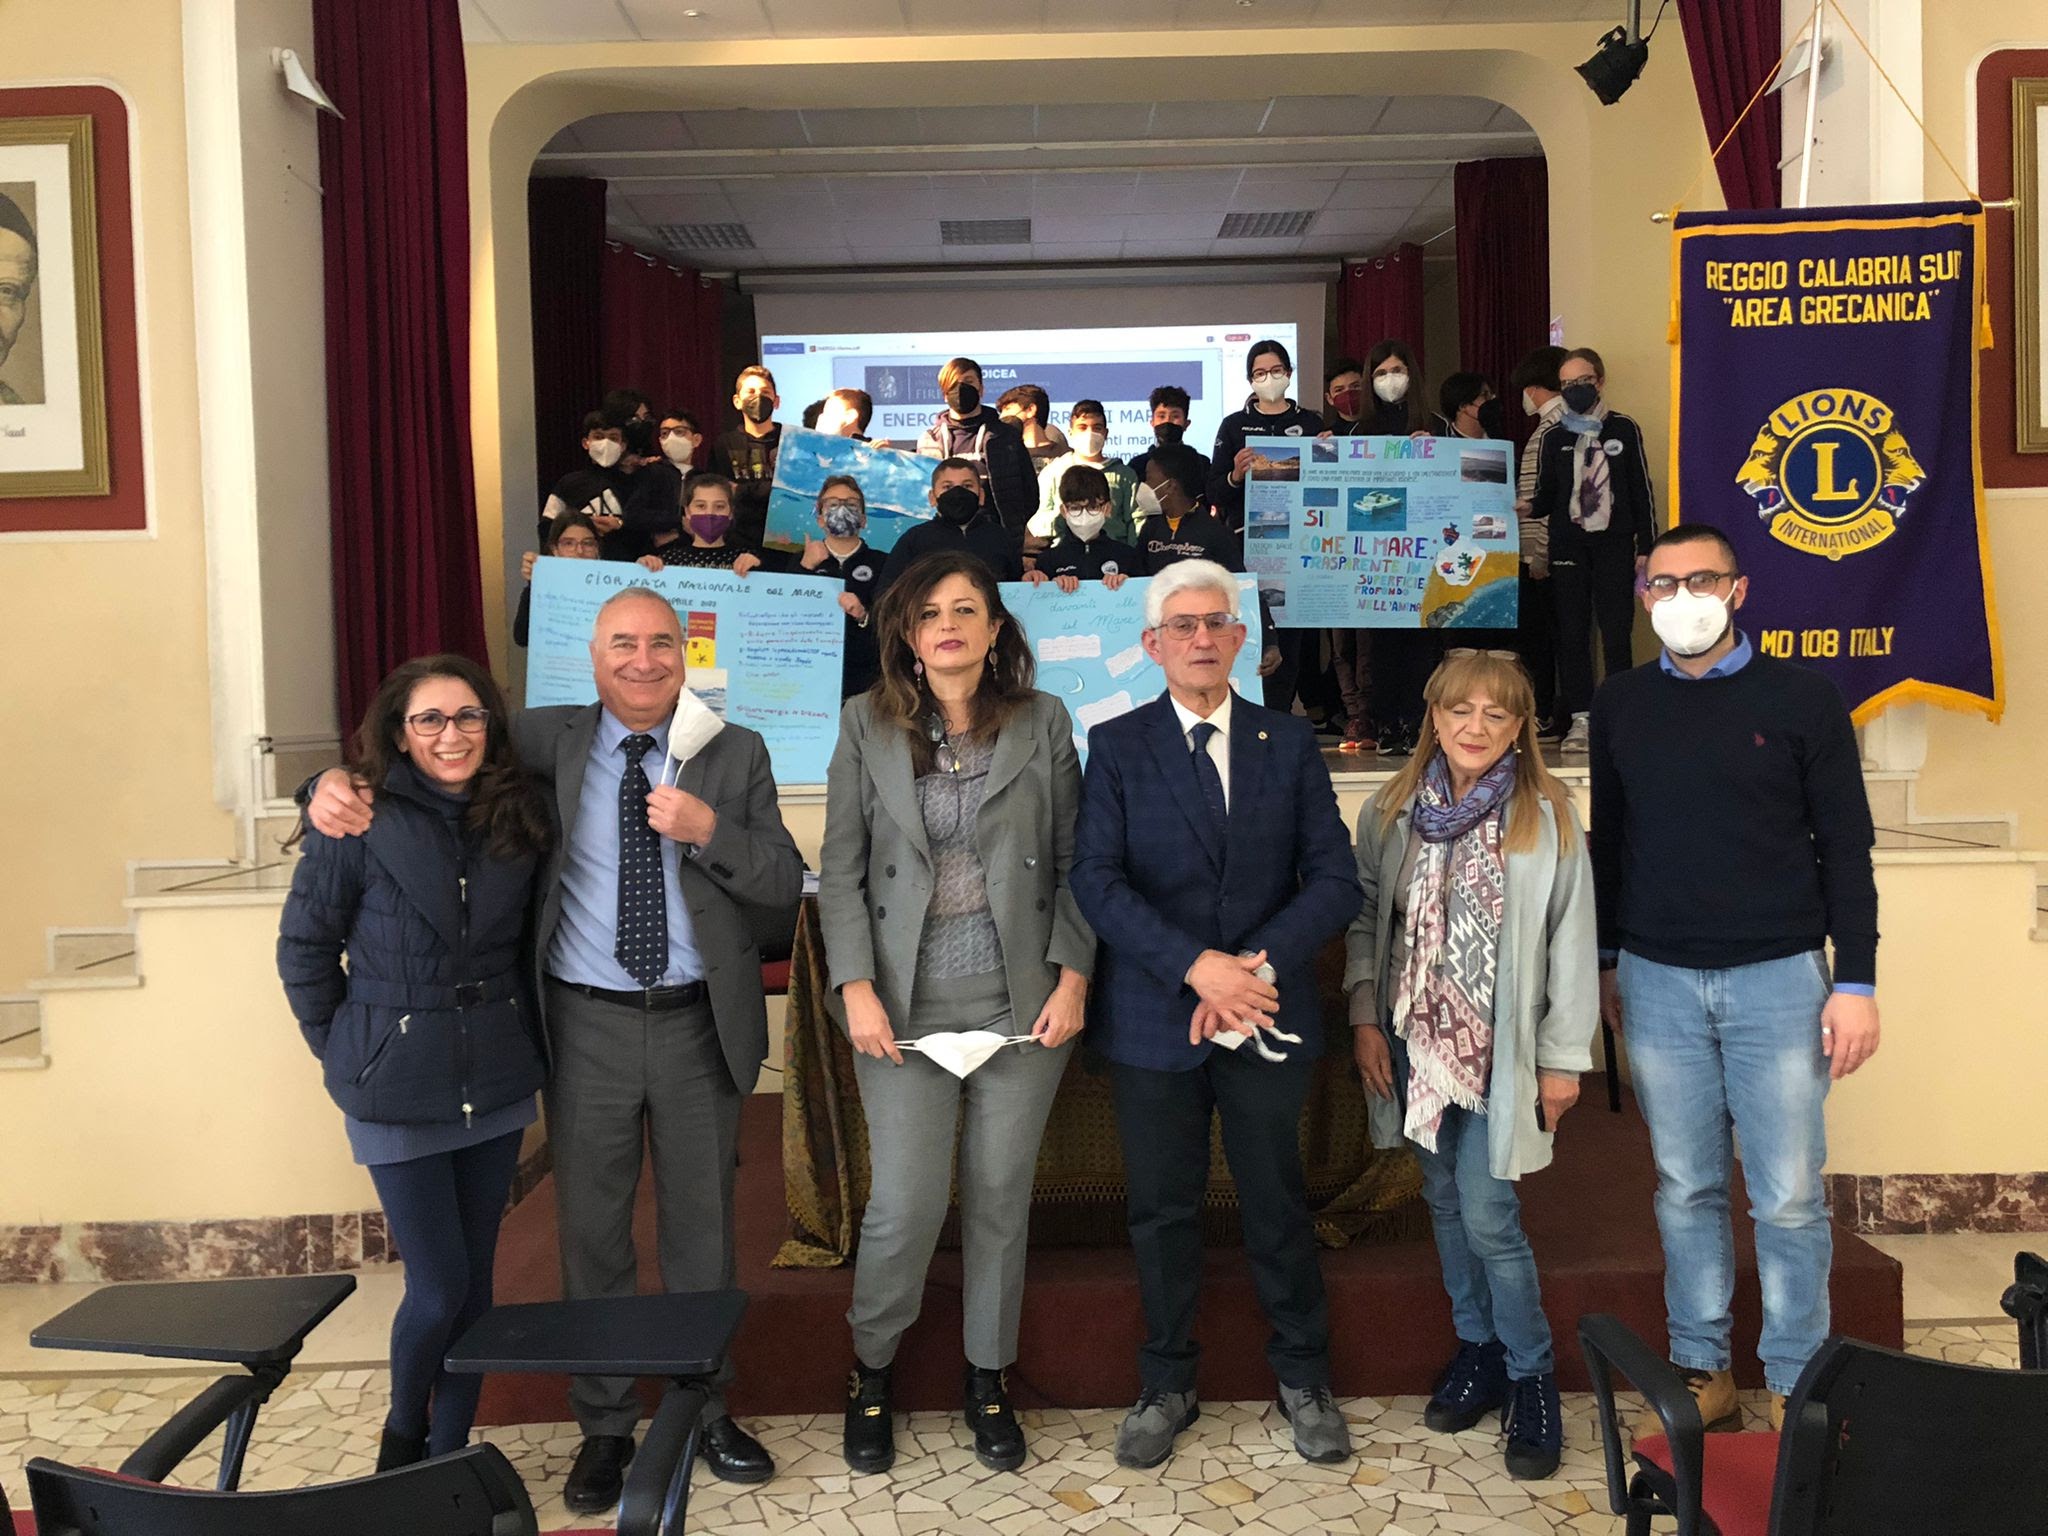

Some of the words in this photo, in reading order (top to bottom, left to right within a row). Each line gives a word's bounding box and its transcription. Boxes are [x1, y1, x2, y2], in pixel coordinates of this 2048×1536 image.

[1706, 260, 1788, 292] REGGIO
[1799, 254, 1913, 288] CALABRIA
[1722, 297, 1793, 327] "AREA
[1800, 289, 1940, 325] GRECANICA"
[1777, 393, 1887, 434] LIONS
[1348, 439, 1376, 459] IL
[1384, 439, 1436, 459] MARE
[1811, 442, 1859, 500] L
[1300, 535, 1345, 554] COME
[1353, 536, 1368, 555] IL
[1778, 517, 1888, 549] INTERNATIONAL
[1300, 555, 1400, 573] TRASPARENTE
[1406, 560, 1421, 574] IN
[678, 580, 751, 594] NAZIONALE
[791, 587, 824, 599] MARE
[1357, 573, 1425, 590] SUPERFICIE
[1760, 629, 1794, 658] MD
[1800, 629, 1840, 657] 108
[1850, 626, 1895, 657] ITALY
